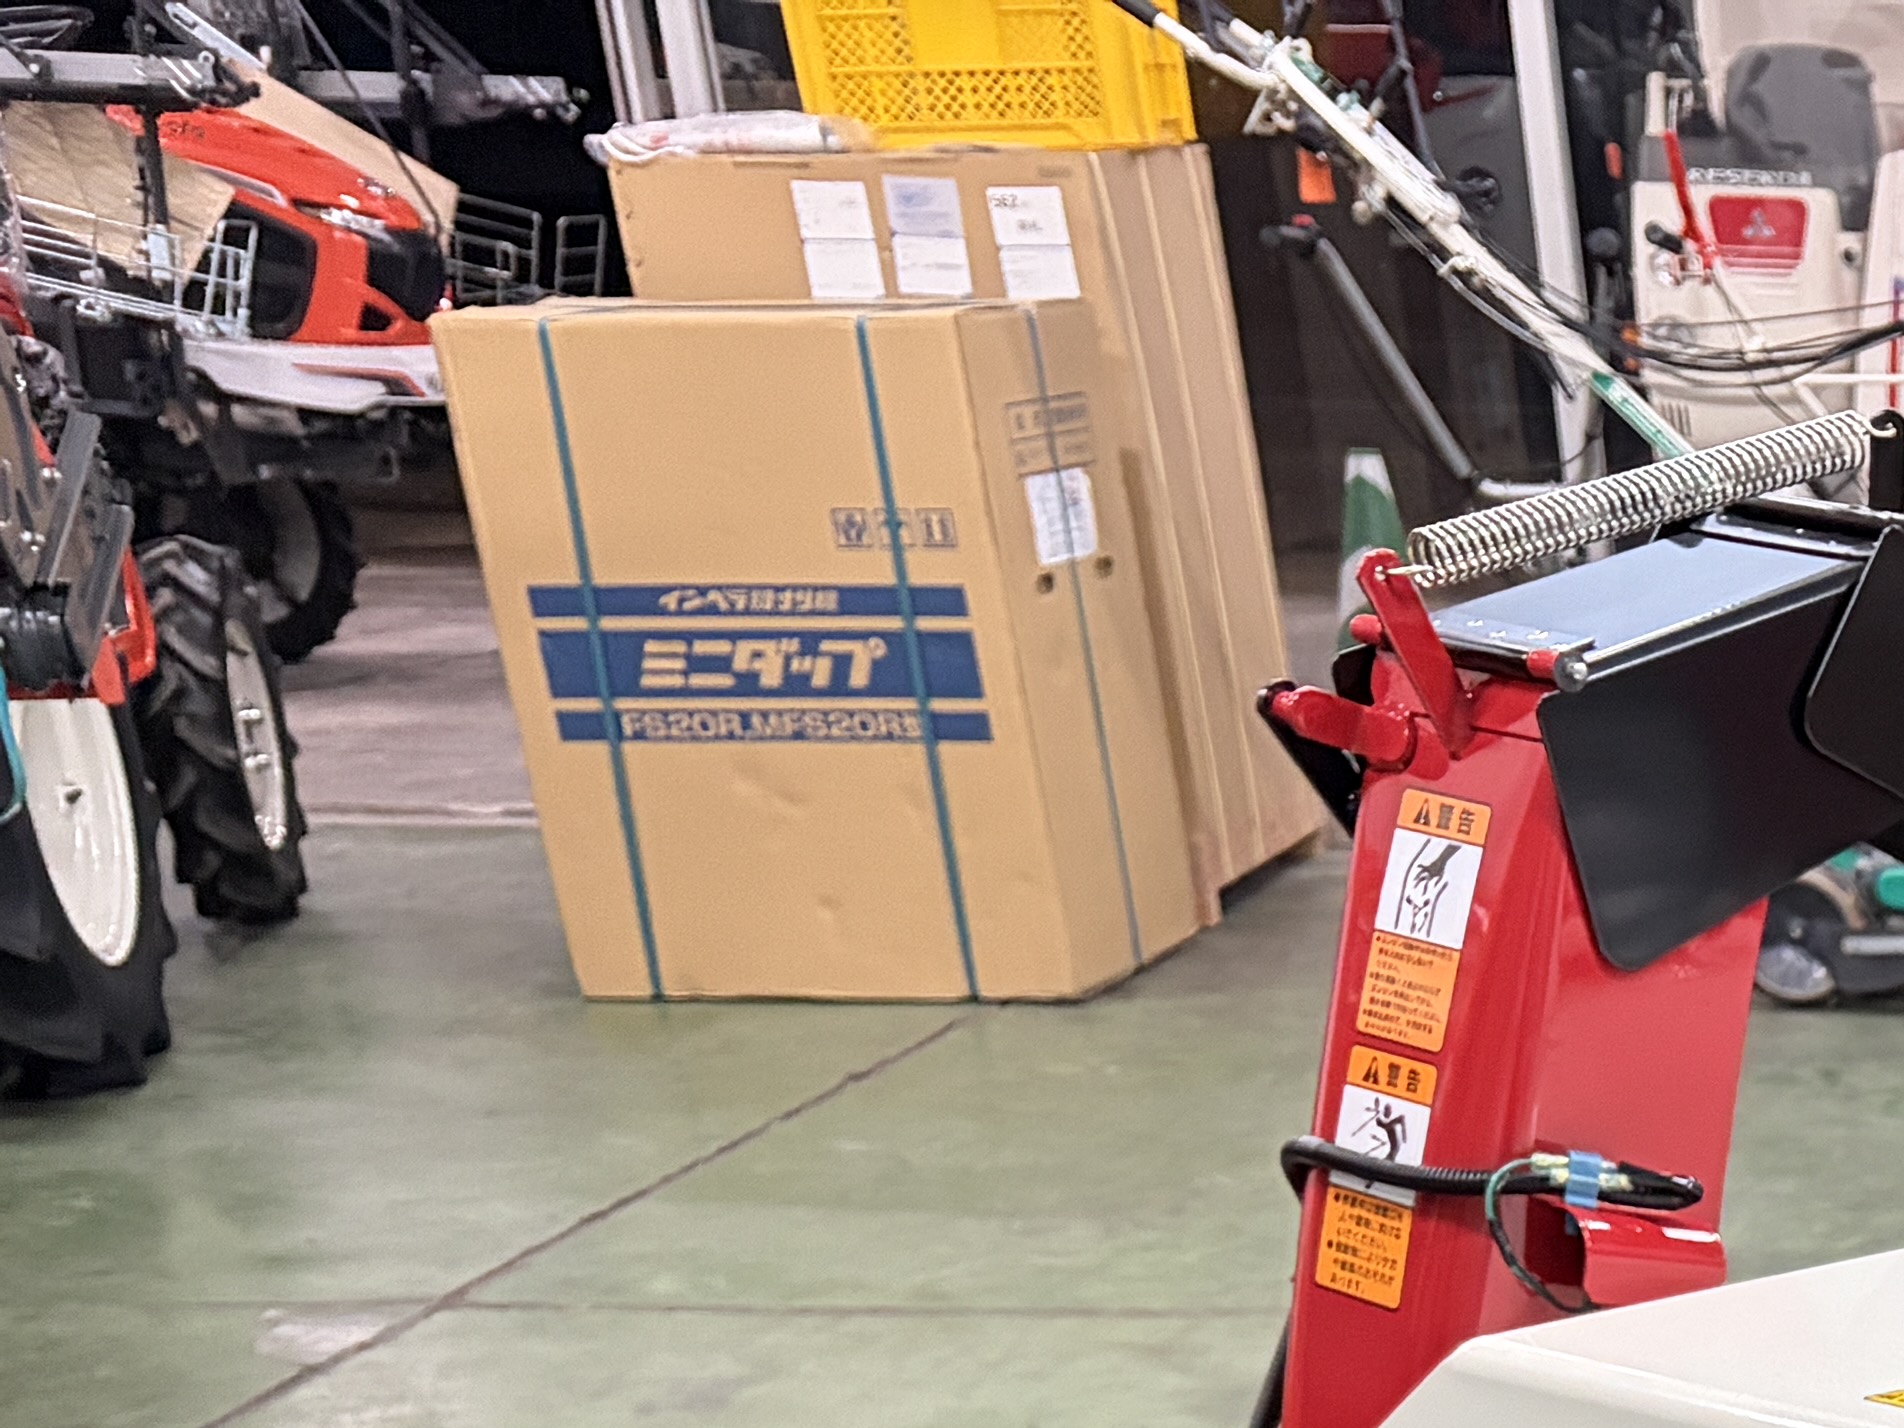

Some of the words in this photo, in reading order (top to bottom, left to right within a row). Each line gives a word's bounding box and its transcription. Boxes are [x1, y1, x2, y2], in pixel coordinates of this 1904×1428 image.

[640, 637, 887, 688] ミニダップ
